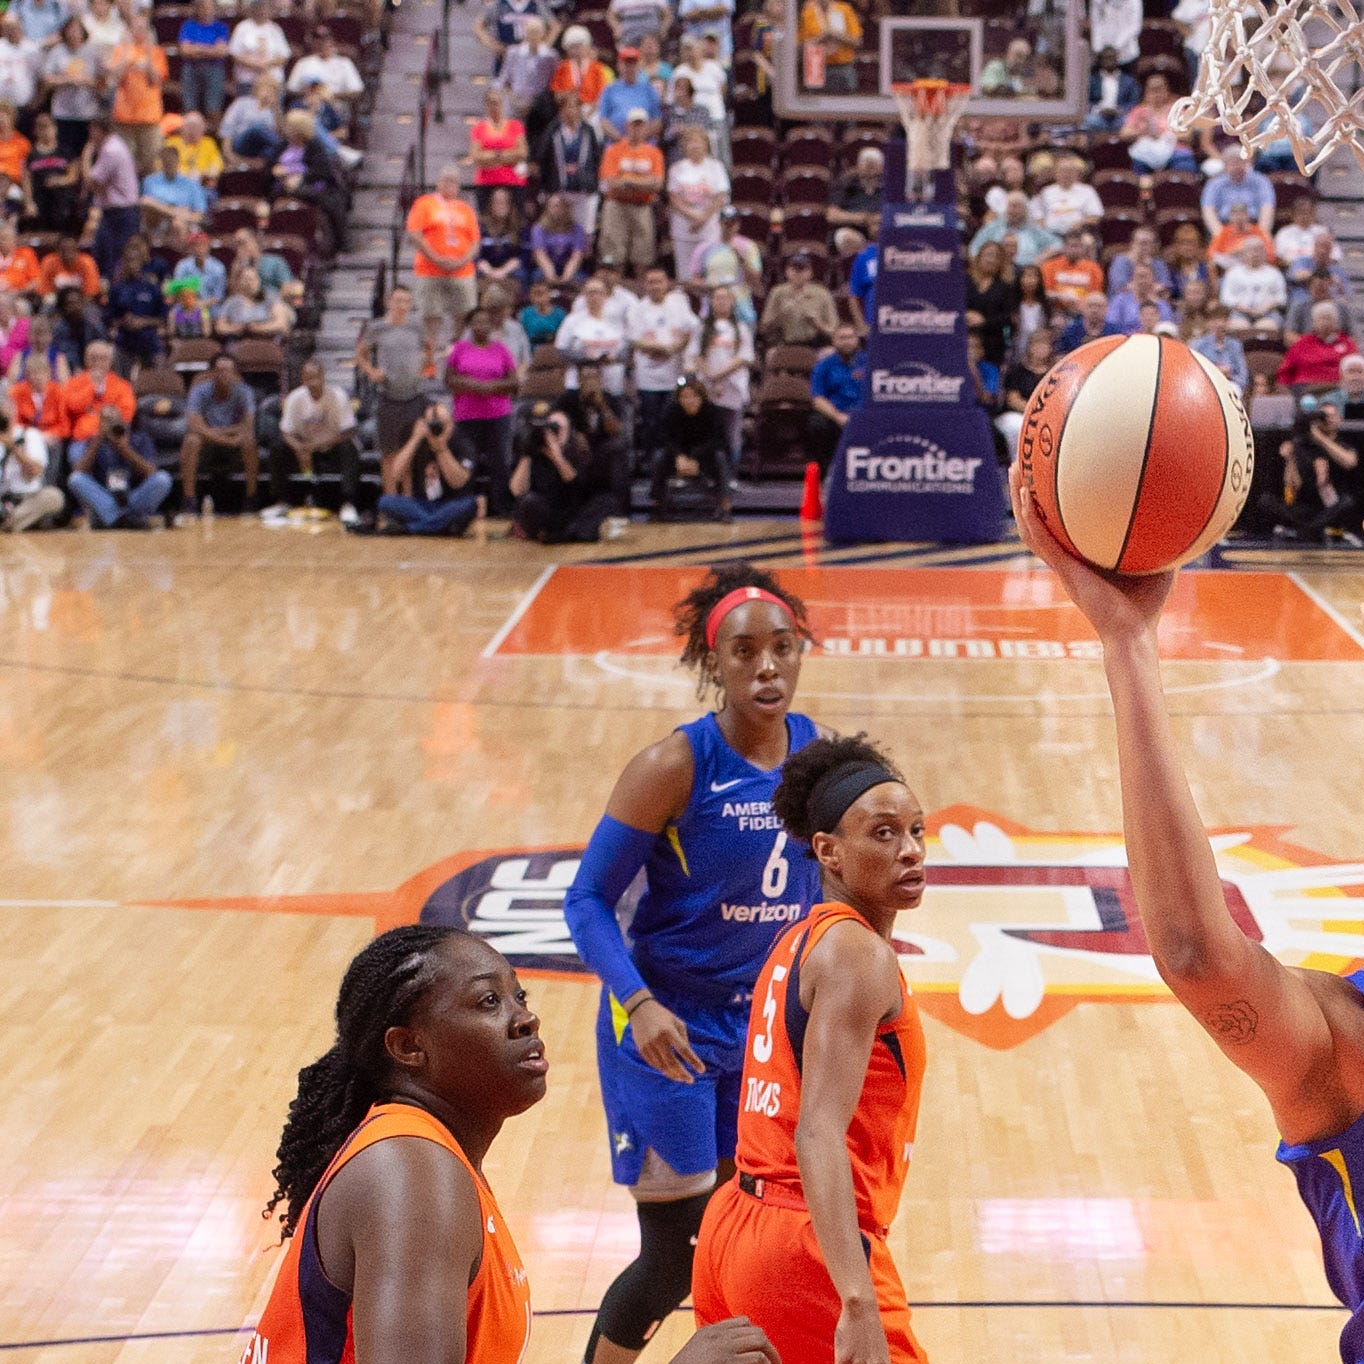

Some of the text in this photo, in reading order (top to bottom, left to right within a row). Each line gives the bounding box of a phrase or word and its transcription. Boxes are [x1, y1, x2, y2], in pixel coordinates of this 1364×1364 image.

[877, 305, 959, 327] Frontier
[872, 369, 965, 394] Frontier
[846, 447, 983, 482] Frontier
[722, 801, 776, 818] AMER
[739, 816, 784, 832] FIDEL
[761, 830, 789, 899] 6
[721, 901, 801, 923] verizon
[753, 964, 788, 1063] 5
